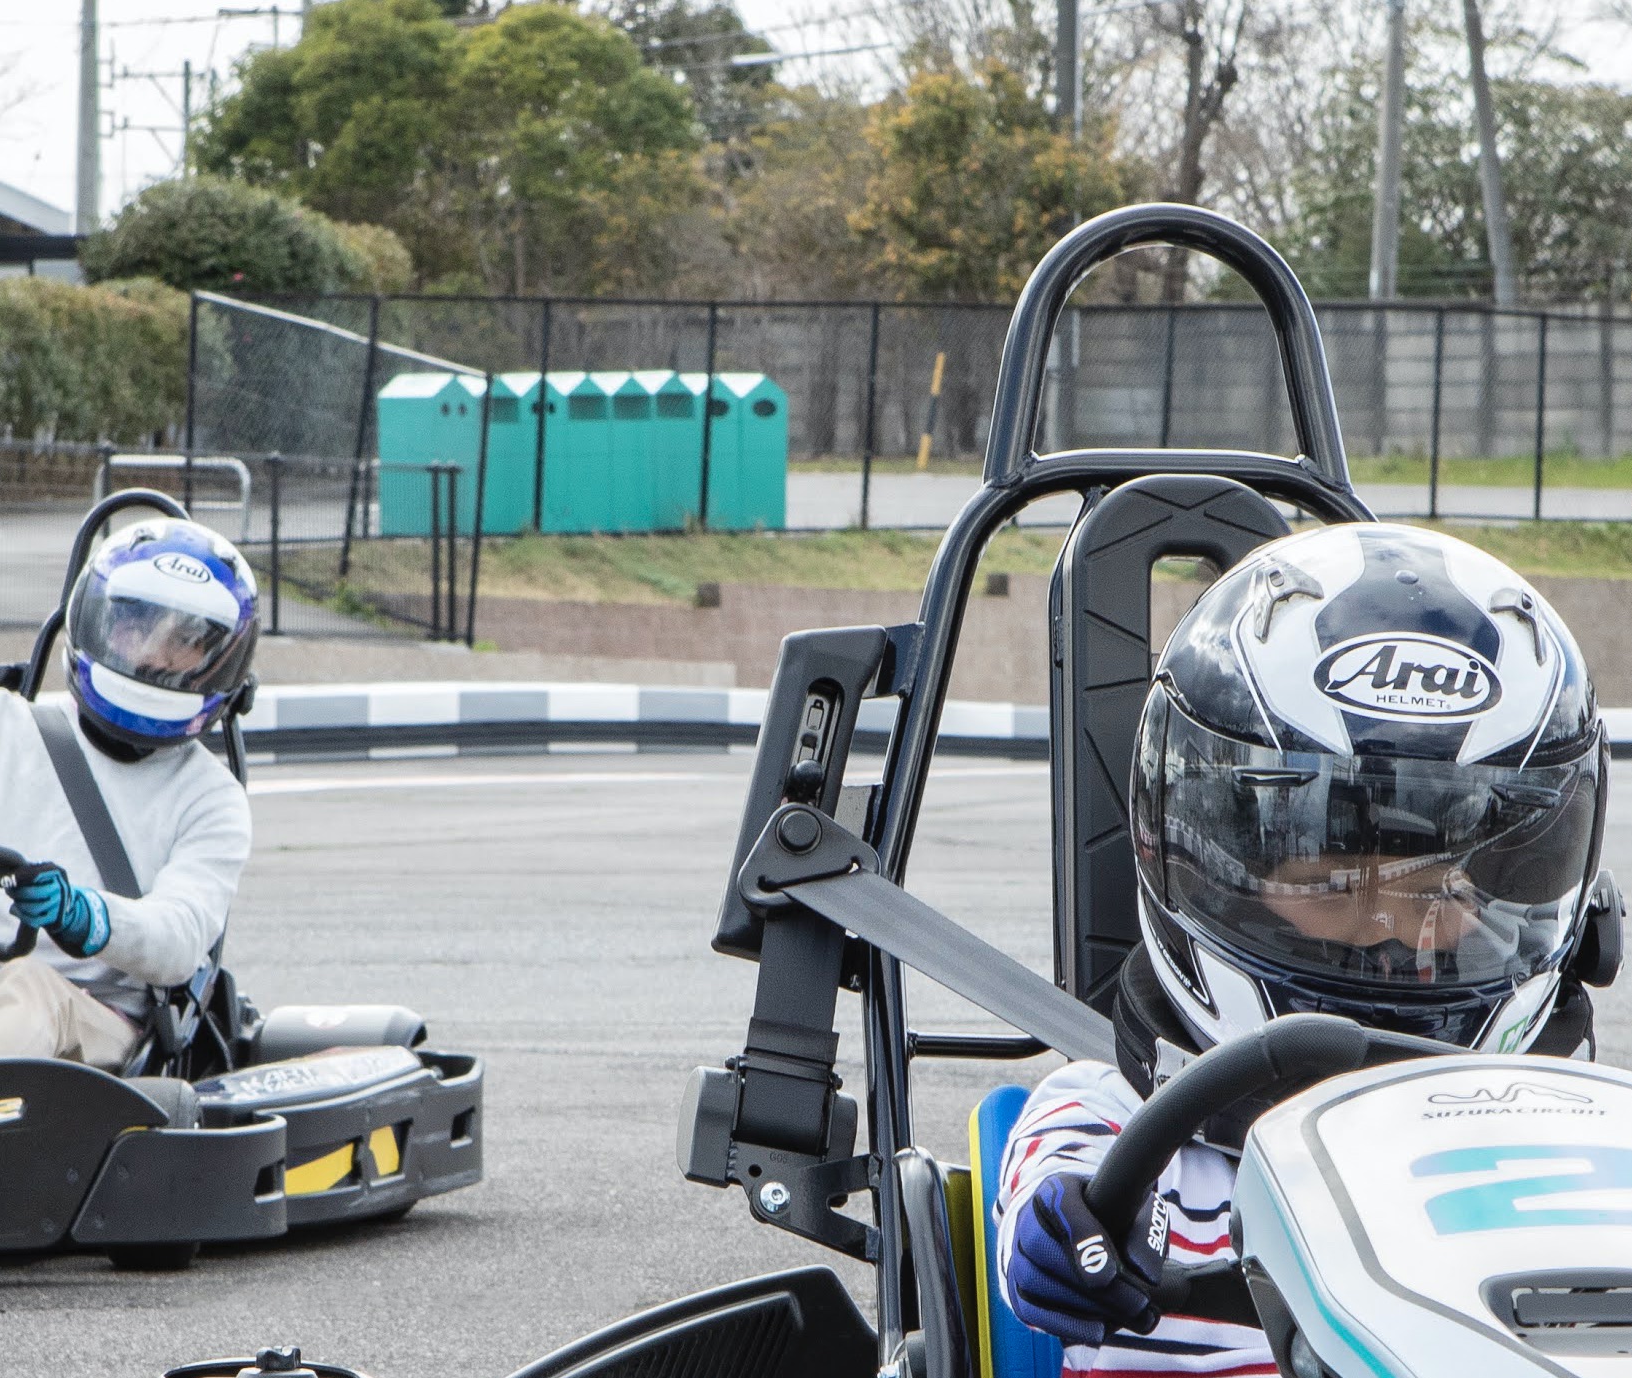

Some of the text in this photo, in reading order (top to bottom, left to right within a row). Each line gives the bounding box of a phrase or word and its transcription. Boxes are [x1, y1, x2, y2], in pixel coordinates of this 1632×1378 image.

[166, 556, 205, 579] Arai
[1326, 644, 1483, 699] Arai
[1376, 694, 1446, 709] HELMET
[1147, 1193, 1169, 1257] sparco
